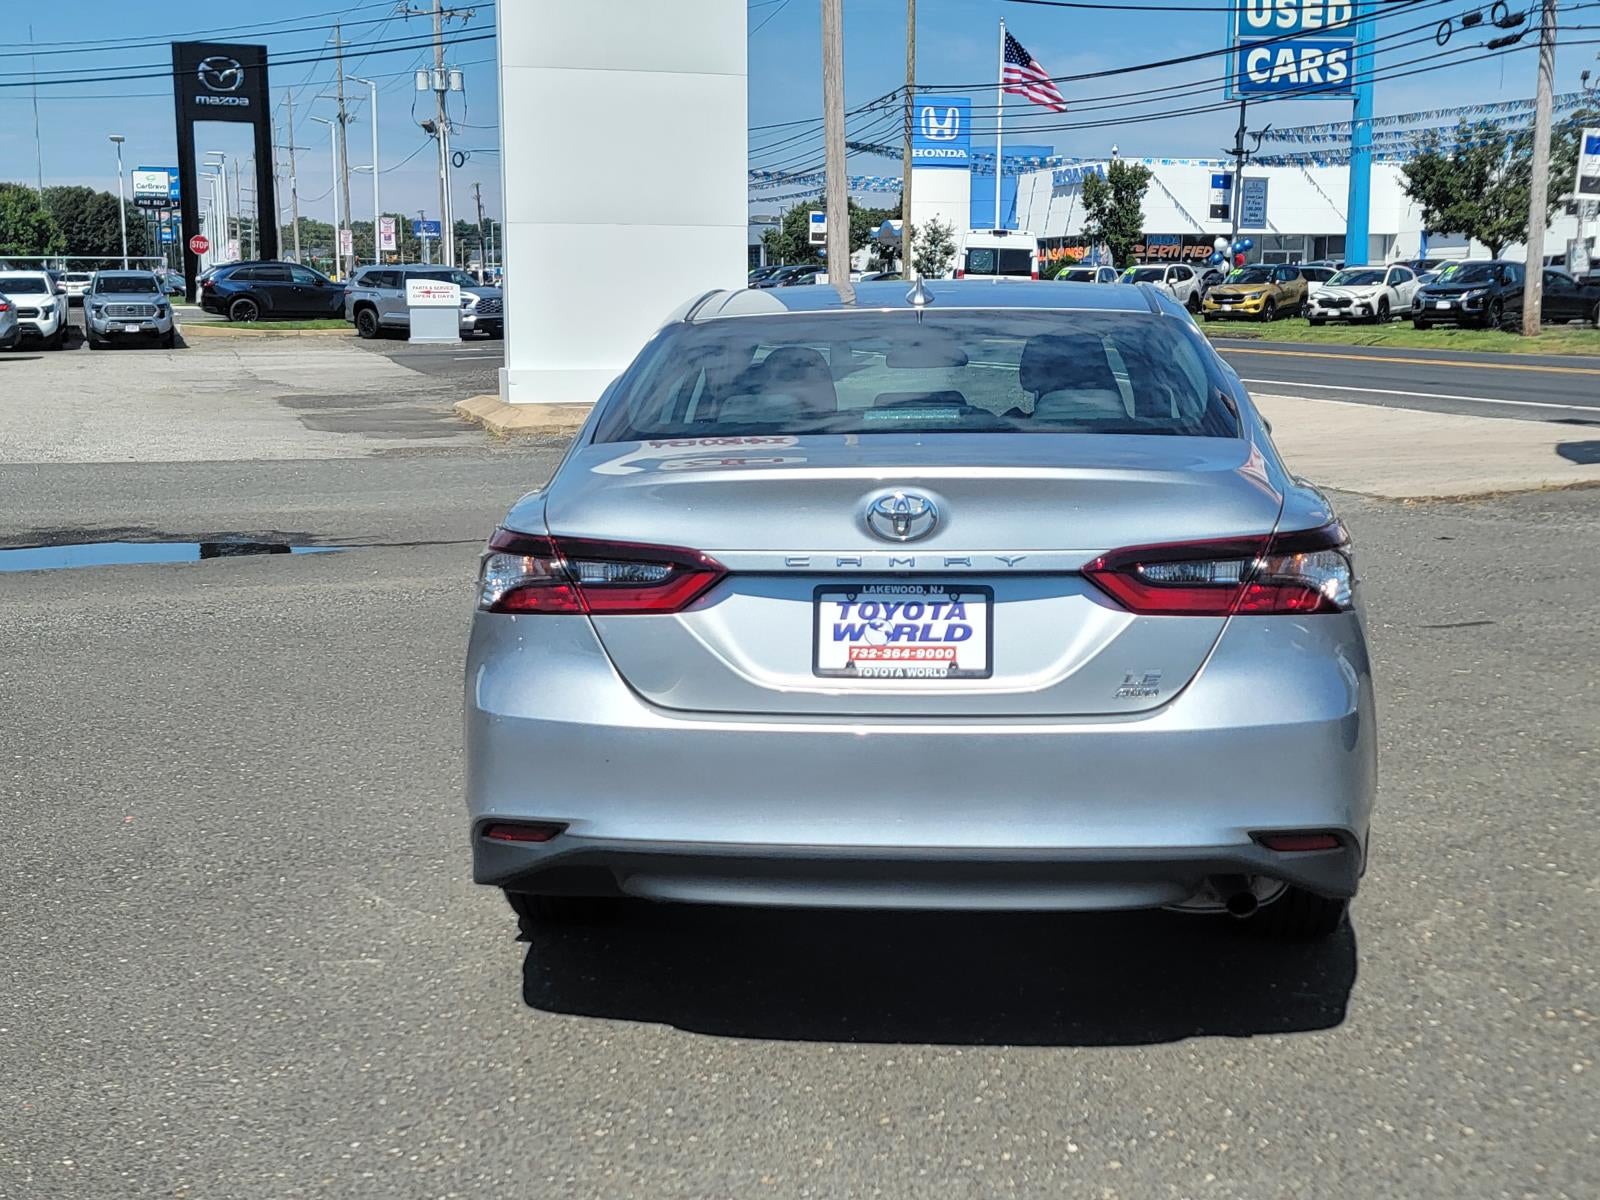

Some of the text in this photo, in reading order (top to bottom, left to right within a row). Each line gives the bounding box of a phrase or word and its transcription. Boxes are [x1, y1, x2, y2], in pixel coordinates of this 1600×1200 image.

[1247, 0, 1352, 28] USED
[1247, 48, 1348, 83] CARS
[912, 149, 968, 158] HONDA
[191, 241, 208, 249] STOP
[785, 556, 1026, 568] CAMRY
[863, 585, 944, 595] LAKEWOOD, NJ
[837, 601, 968, 621] TOYOTA
[851, 647, 955, 659] 732-364-9000
[857, 667, 948, 677] TOYOTA WORLD
